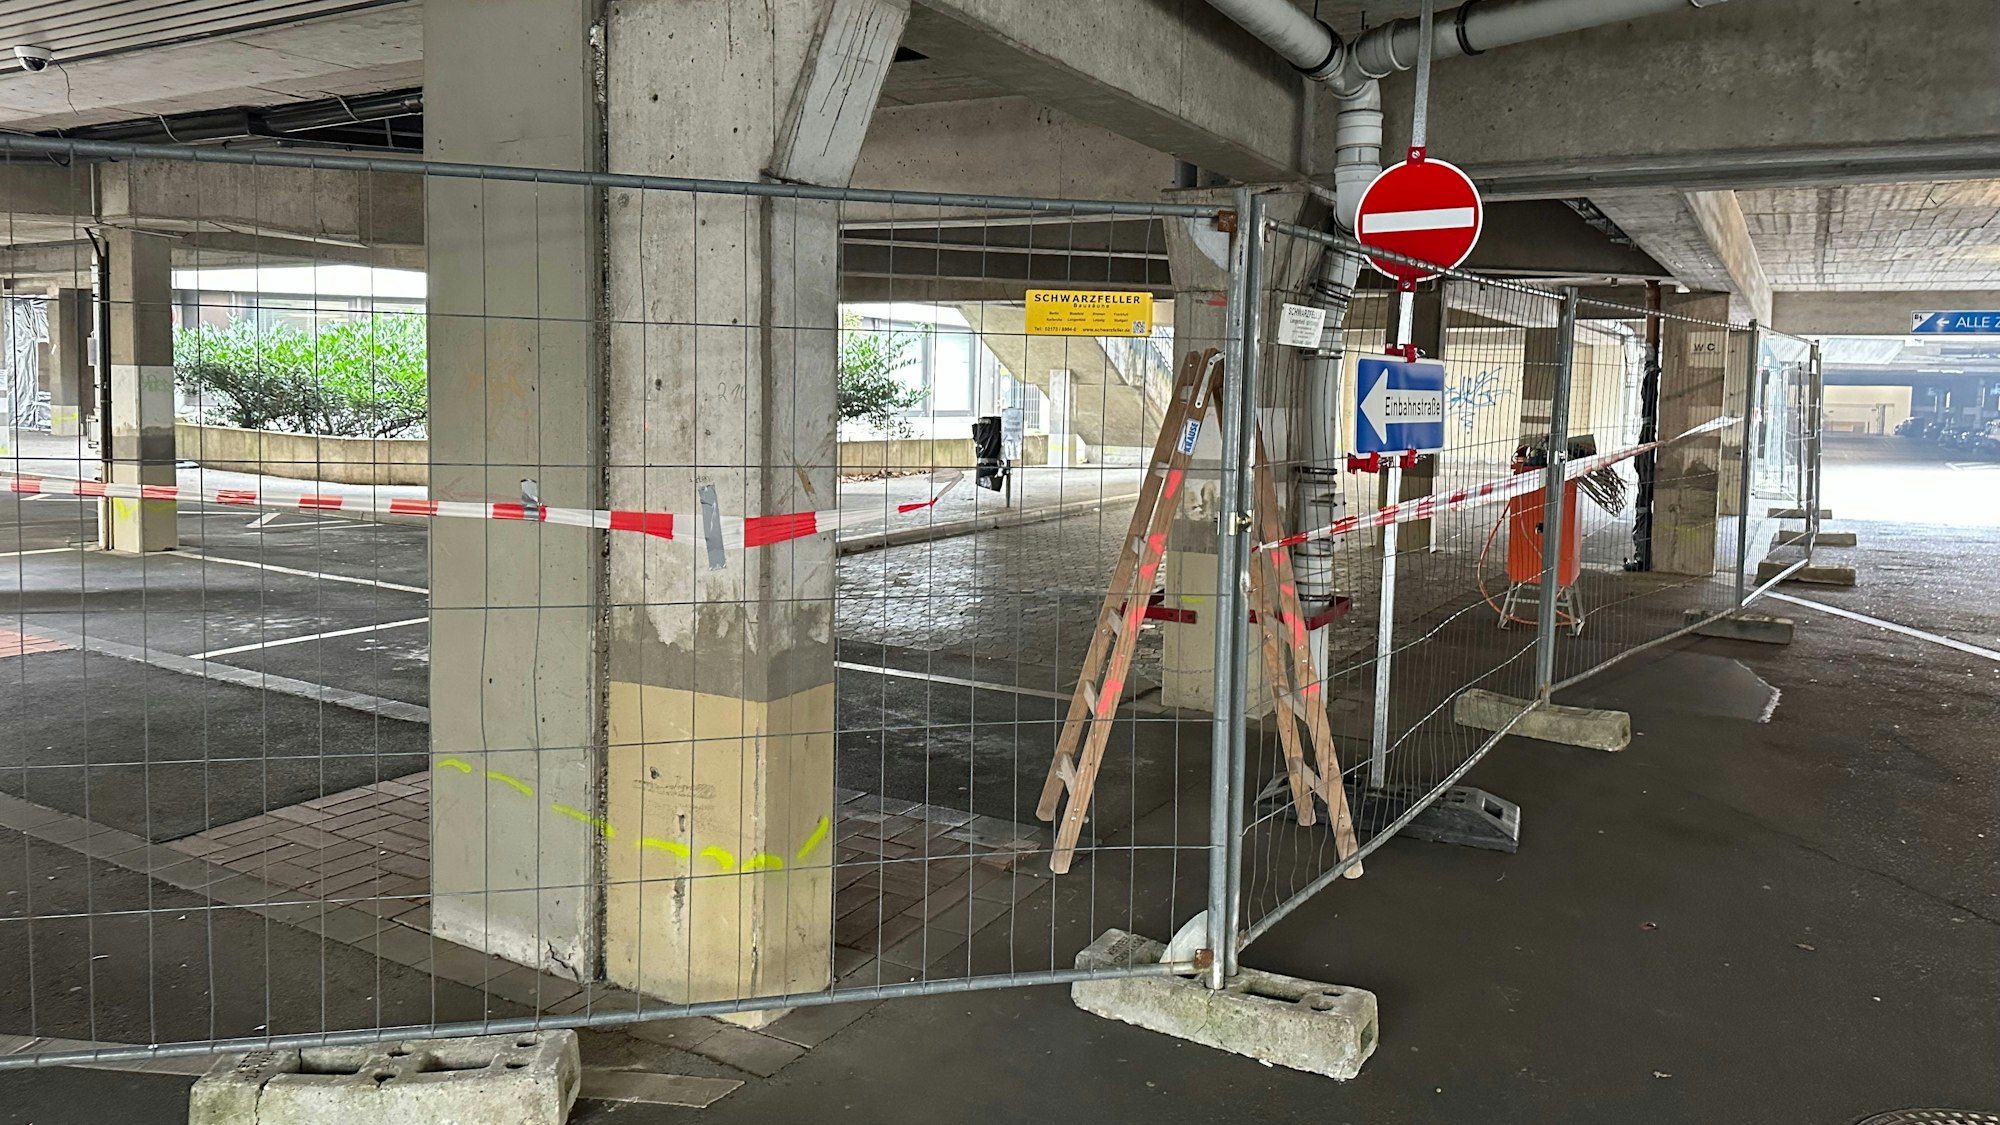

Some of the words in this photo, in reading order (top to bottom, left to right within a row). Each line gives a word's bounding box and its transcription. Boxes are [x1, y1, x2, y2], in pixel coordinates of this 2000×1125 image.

[1034, 293, 1141, 304] SCHWARZFELLER
[1955, 316, 1991, 328] ALLE
[1385, 396, 1441, 417] Einbahnstraße
[1183, 422, 1199, 453] KRAUSE
